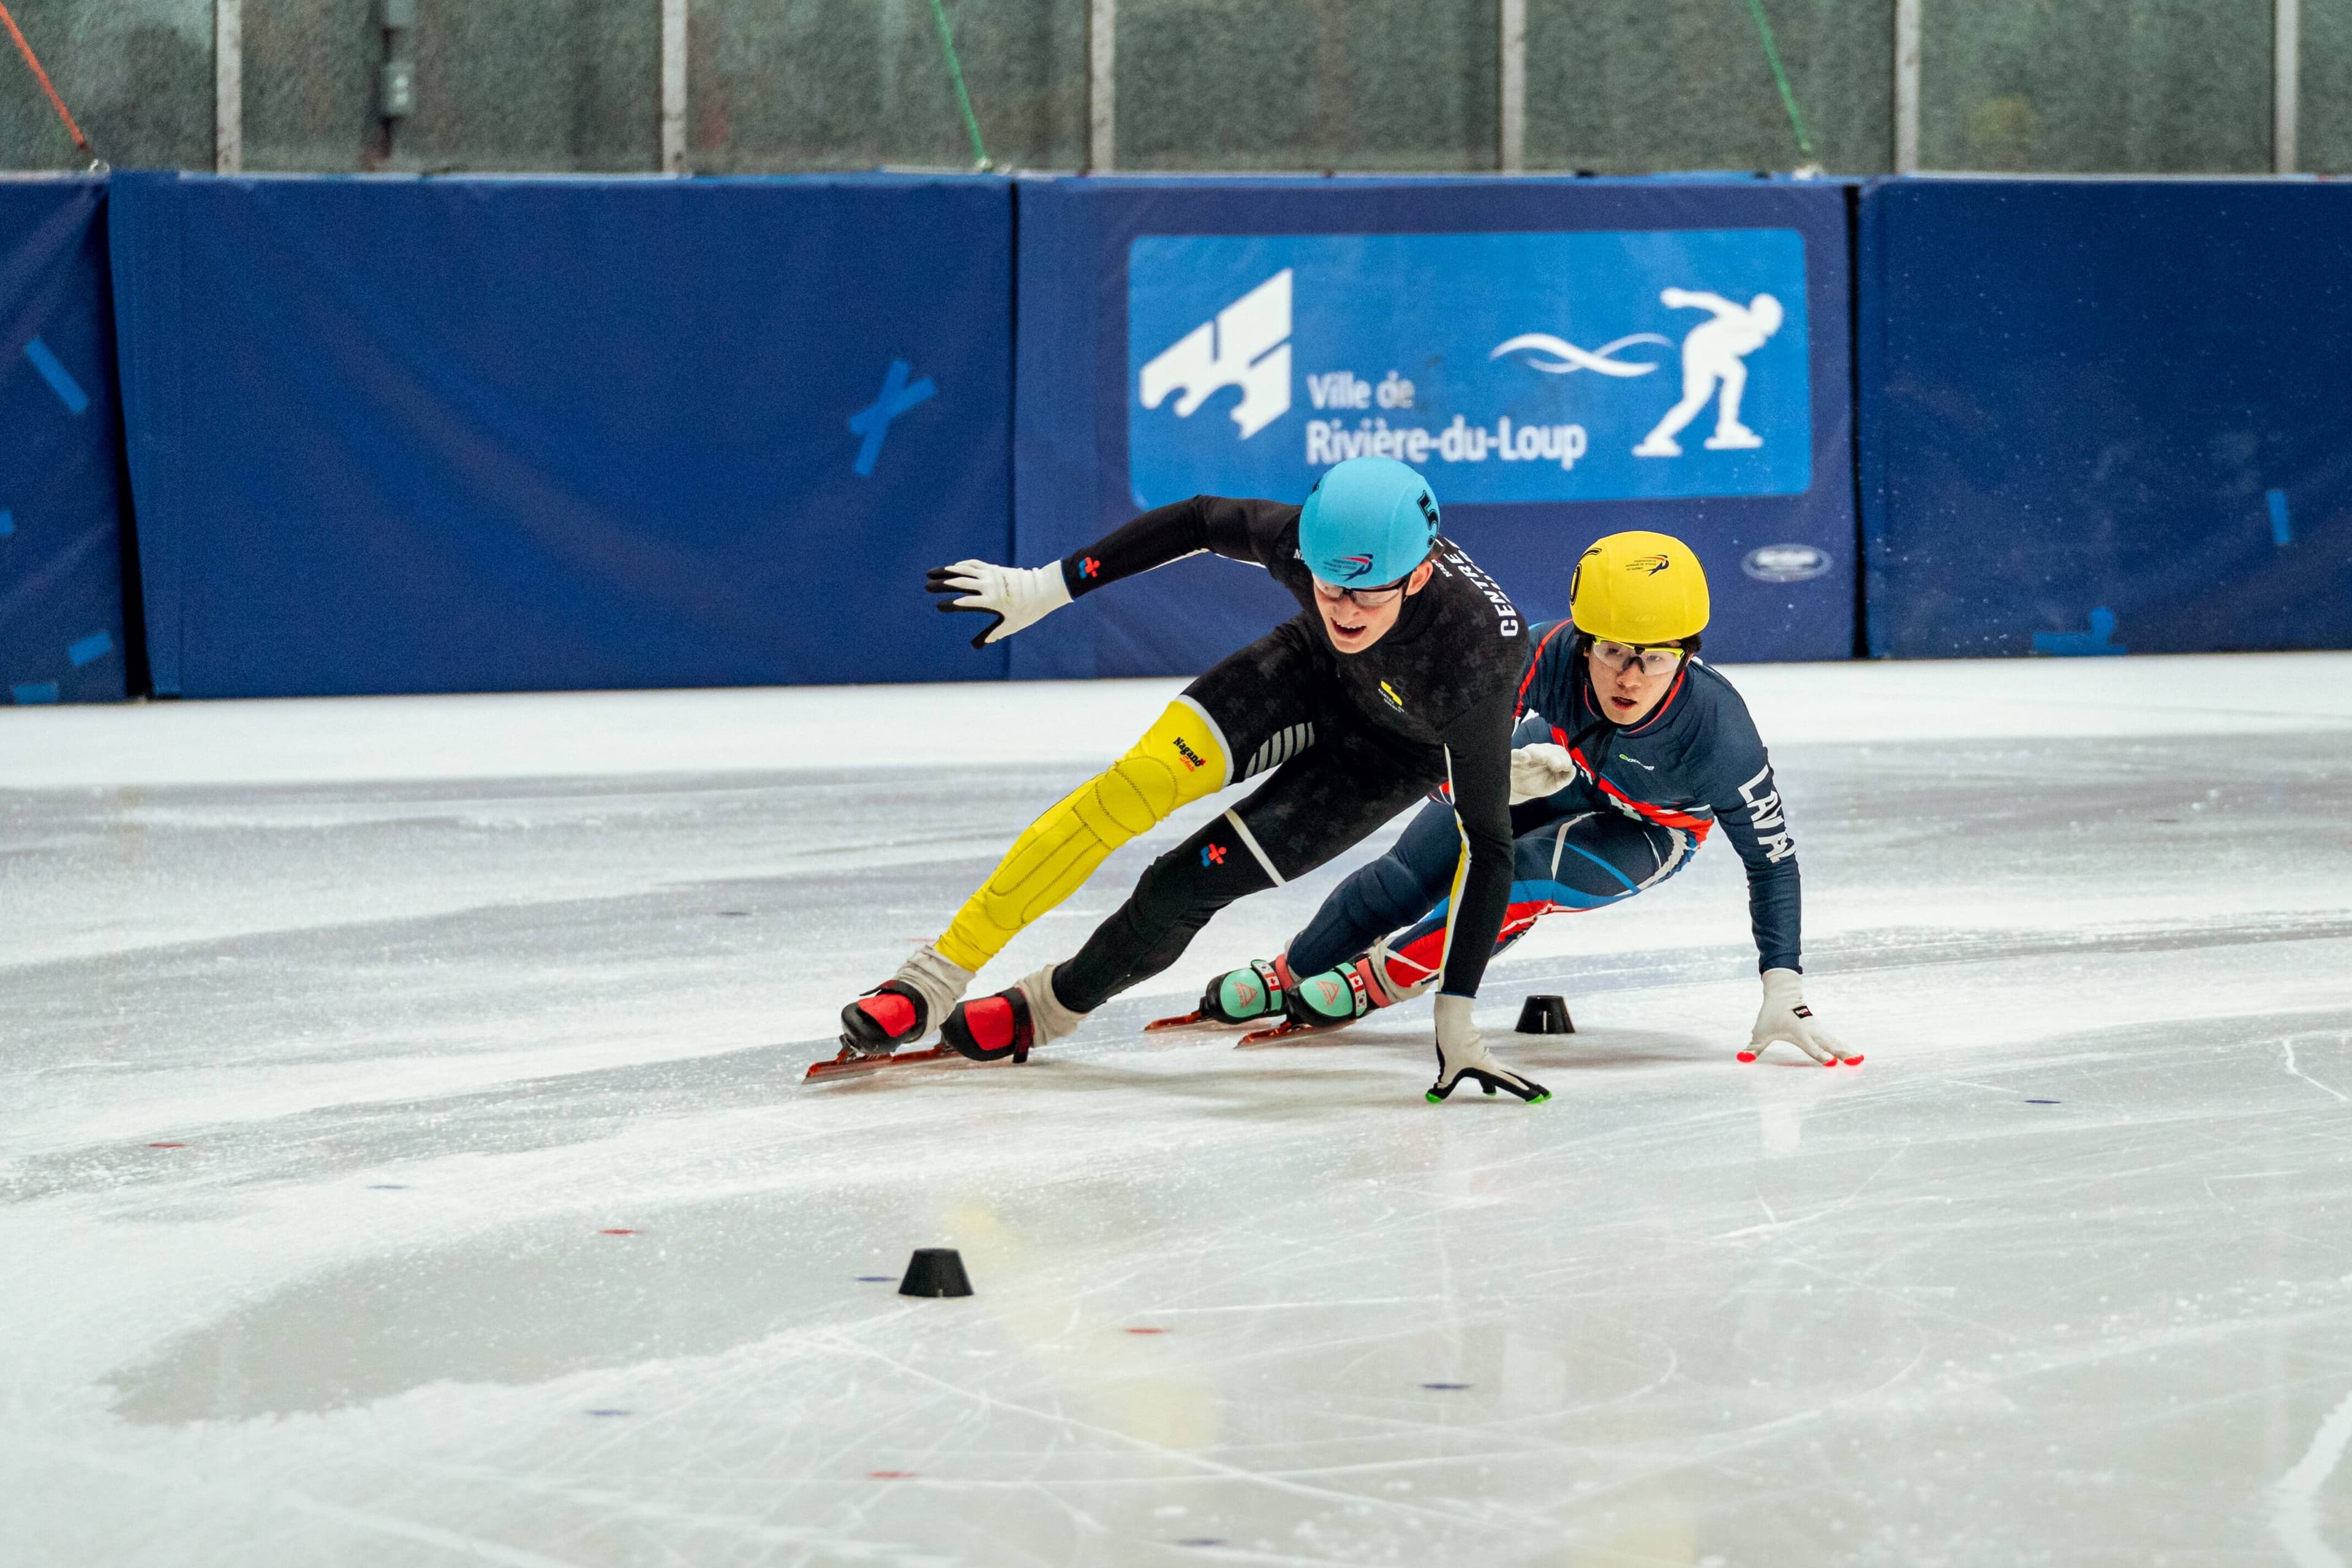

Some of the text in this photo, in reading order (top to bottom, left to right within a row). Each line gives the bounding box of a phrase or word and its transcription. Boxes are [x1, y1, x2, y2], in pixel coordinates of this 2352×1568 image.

[1307, 370, 1415, 409] Ville de
[1306, 415, 1588, 470] Rivière-du-Loup
[1443, 553, 1519, 636] CENTRE
[1173, 737, 1201, 767] Nagano
[1738, 764, 1796, 863] LAVAL
